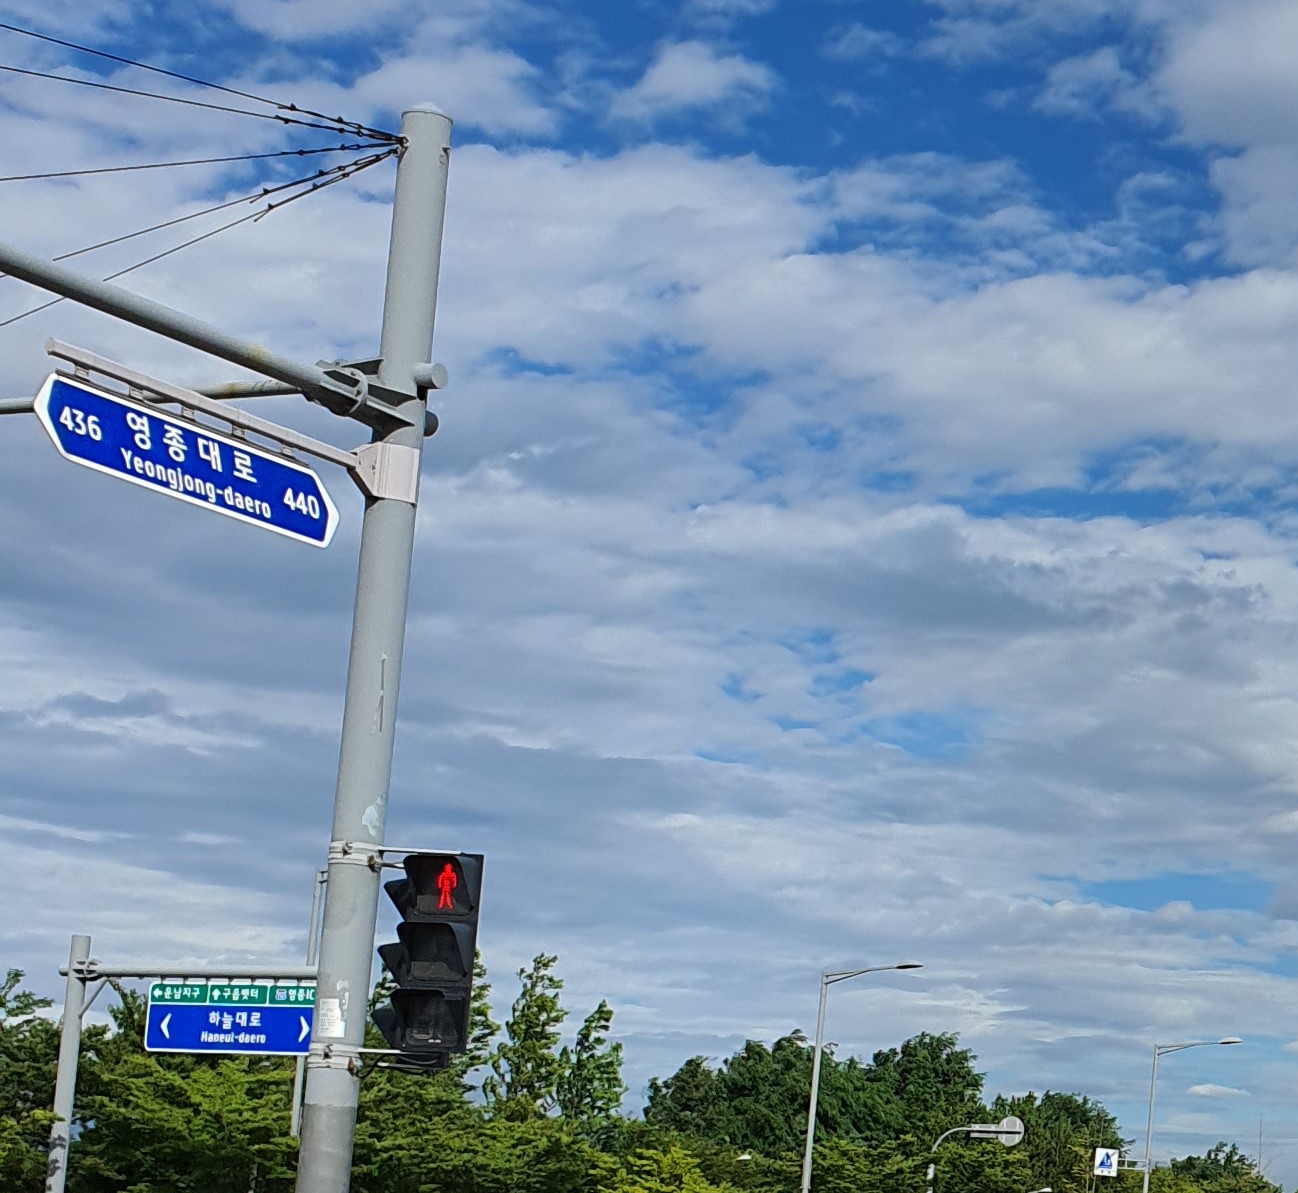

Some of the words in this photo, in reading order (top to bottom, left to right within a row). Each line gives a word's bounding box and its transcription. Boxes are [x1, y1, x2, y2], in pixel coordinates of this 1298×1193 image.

[59, 406, 102, 441] 436
[126, 412, 257, 483] 영종대로
[283, 487, 320, 520] 440
[120, 447, 272, 519] Yeongjong-daero
[164, 986, 200, 999] 운남지구
[208, 1011, 262, 1030] 하늘대로
[201, 1031, 267, 1044] Haneul-daero
